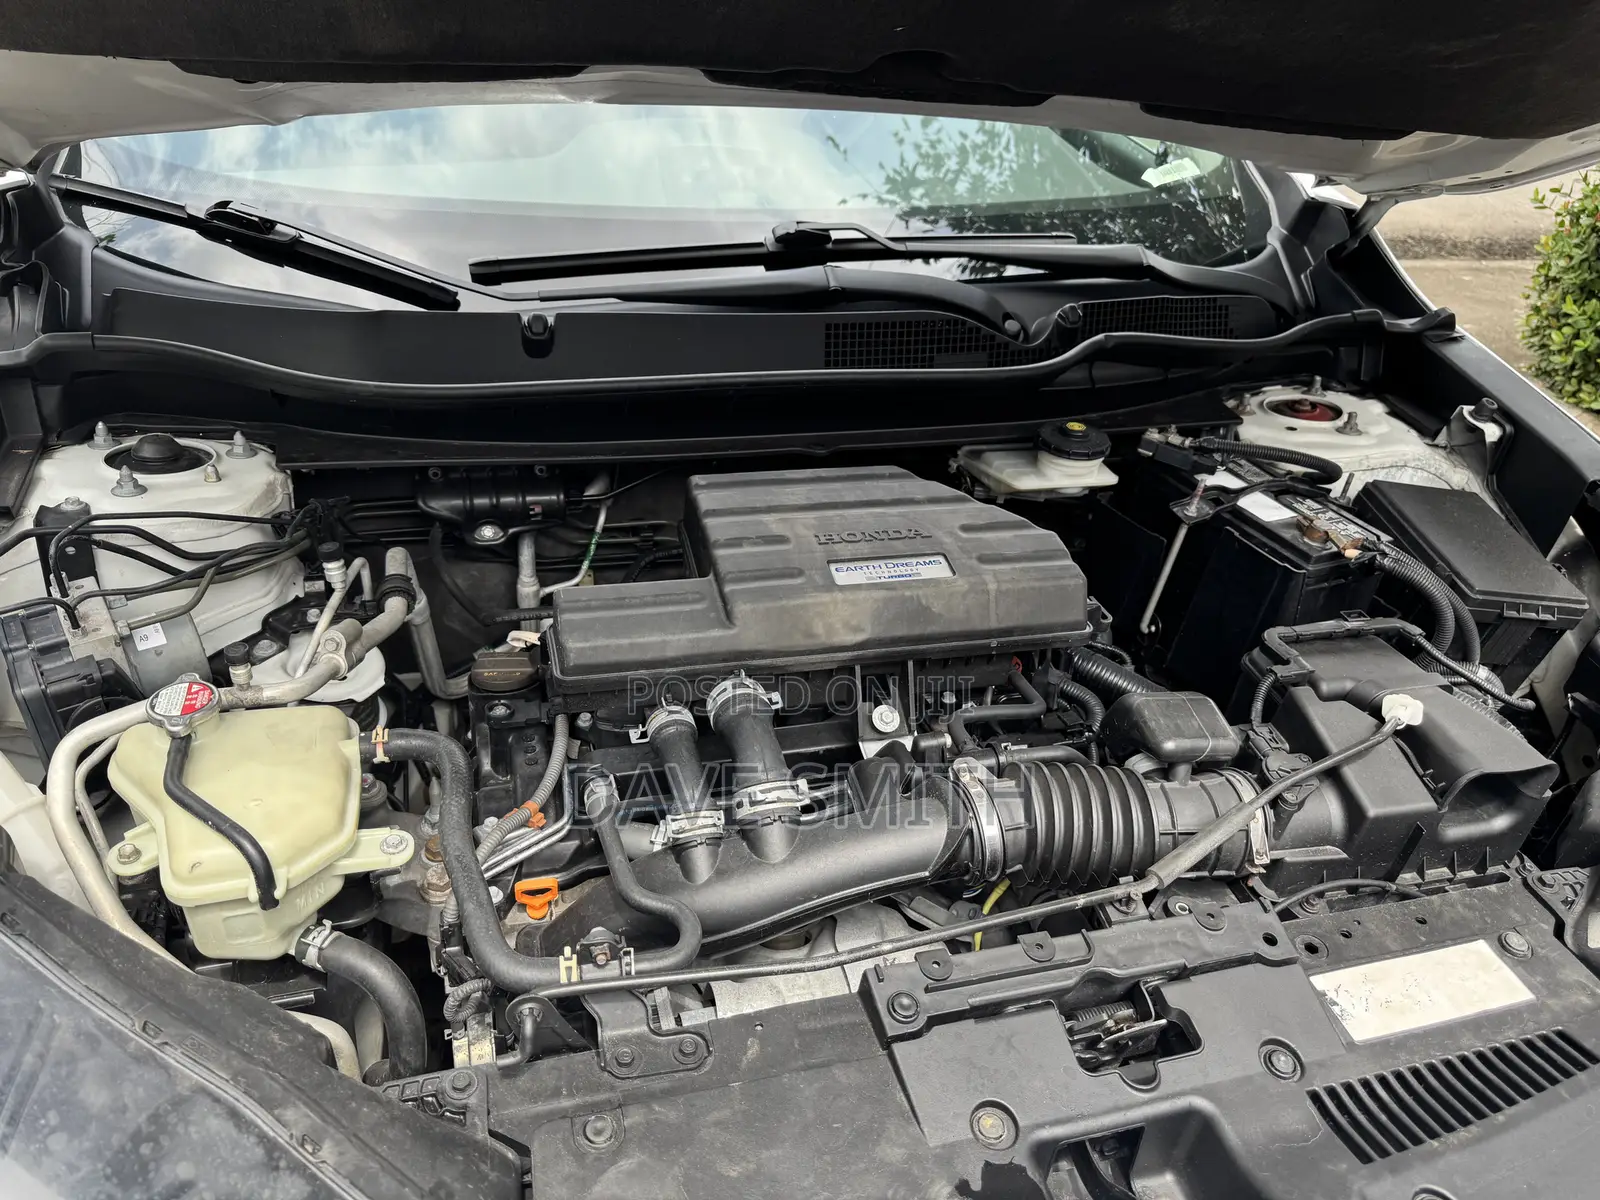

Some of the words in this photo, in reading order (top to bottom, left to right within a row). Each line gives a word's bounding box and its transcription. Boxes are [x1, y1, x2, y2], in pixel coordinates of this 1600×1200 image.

[815, 528, 932, 545] HONDA
[834, 563, 882, 573] EARTH
[884, 559, 942, 571] DREAMS
[140, 634, 149, 642] A9
